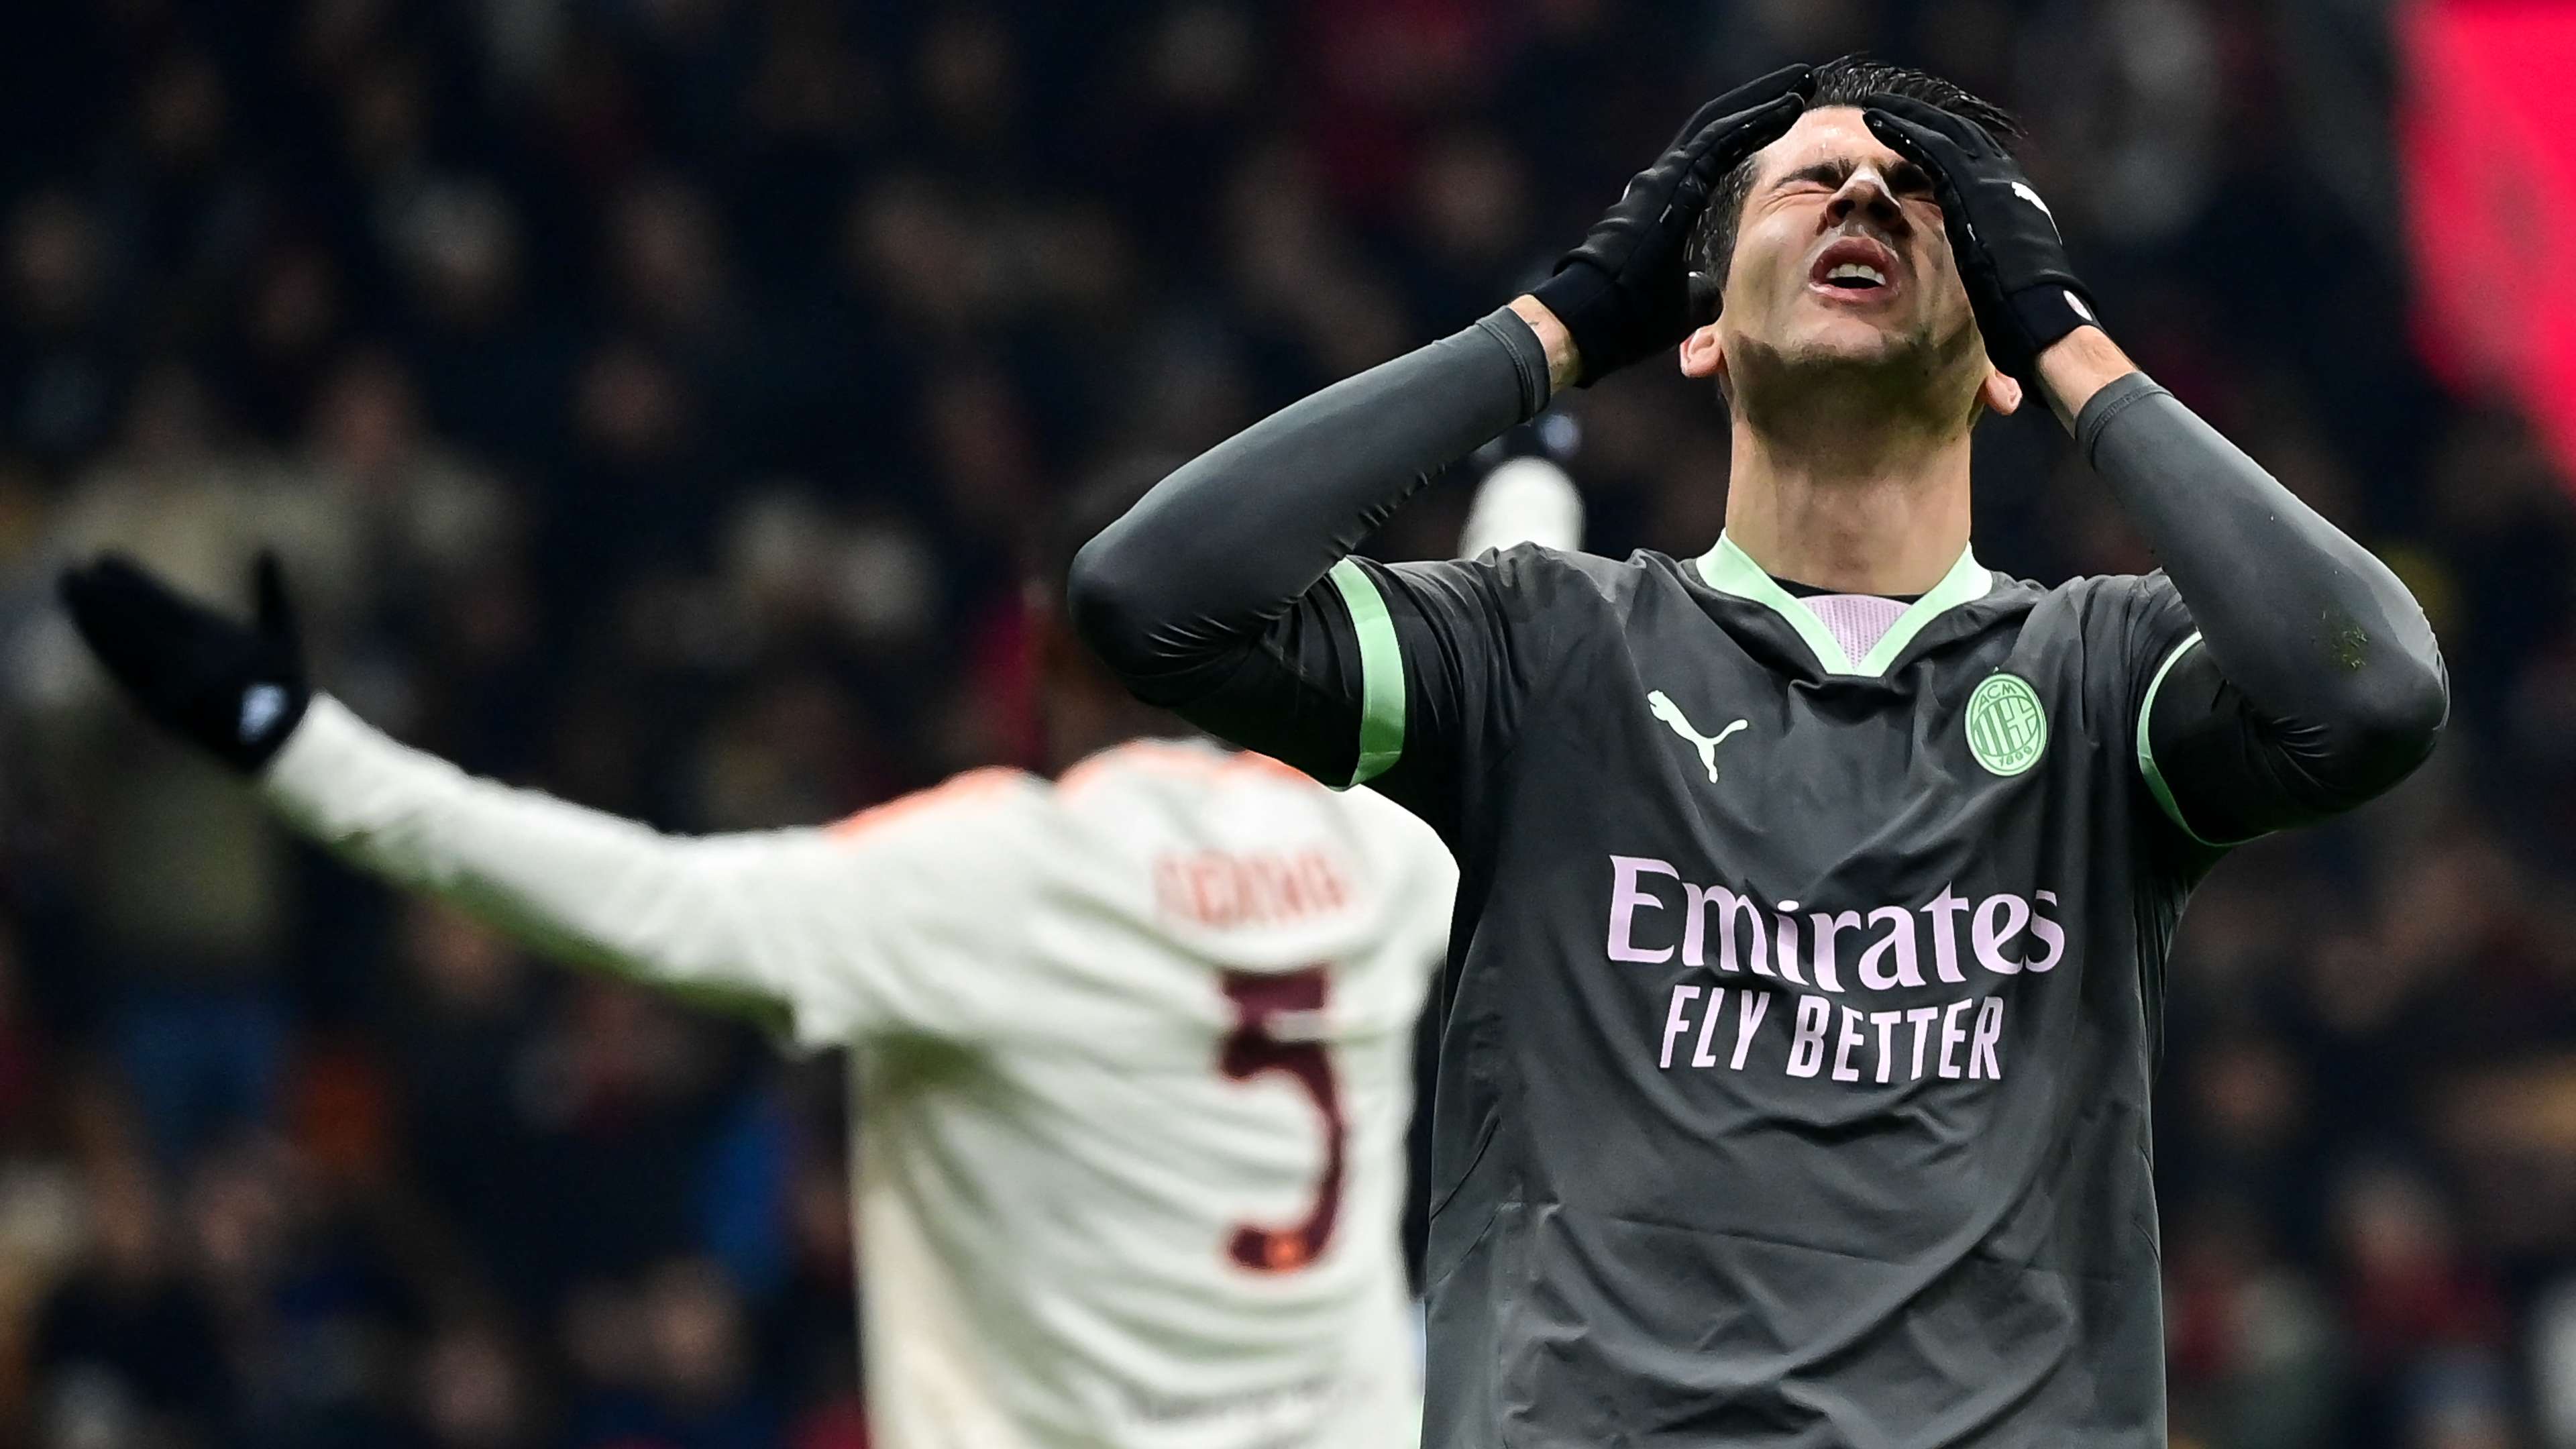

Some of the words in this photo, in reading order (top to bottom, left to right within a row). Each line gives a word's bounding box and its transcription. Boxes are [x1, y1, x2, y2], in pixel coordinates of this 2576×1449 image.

[1978, 683, 2017, 712] ACM
[1999, 745, 2033, 767] 1899
[1608, 855, 2065, 992] Emirates
[1660, 985, 1770, 1070] FLY
[1786, 996, 2004, 1083] BETTER
[1221, 967, 1346, 1272] 5
